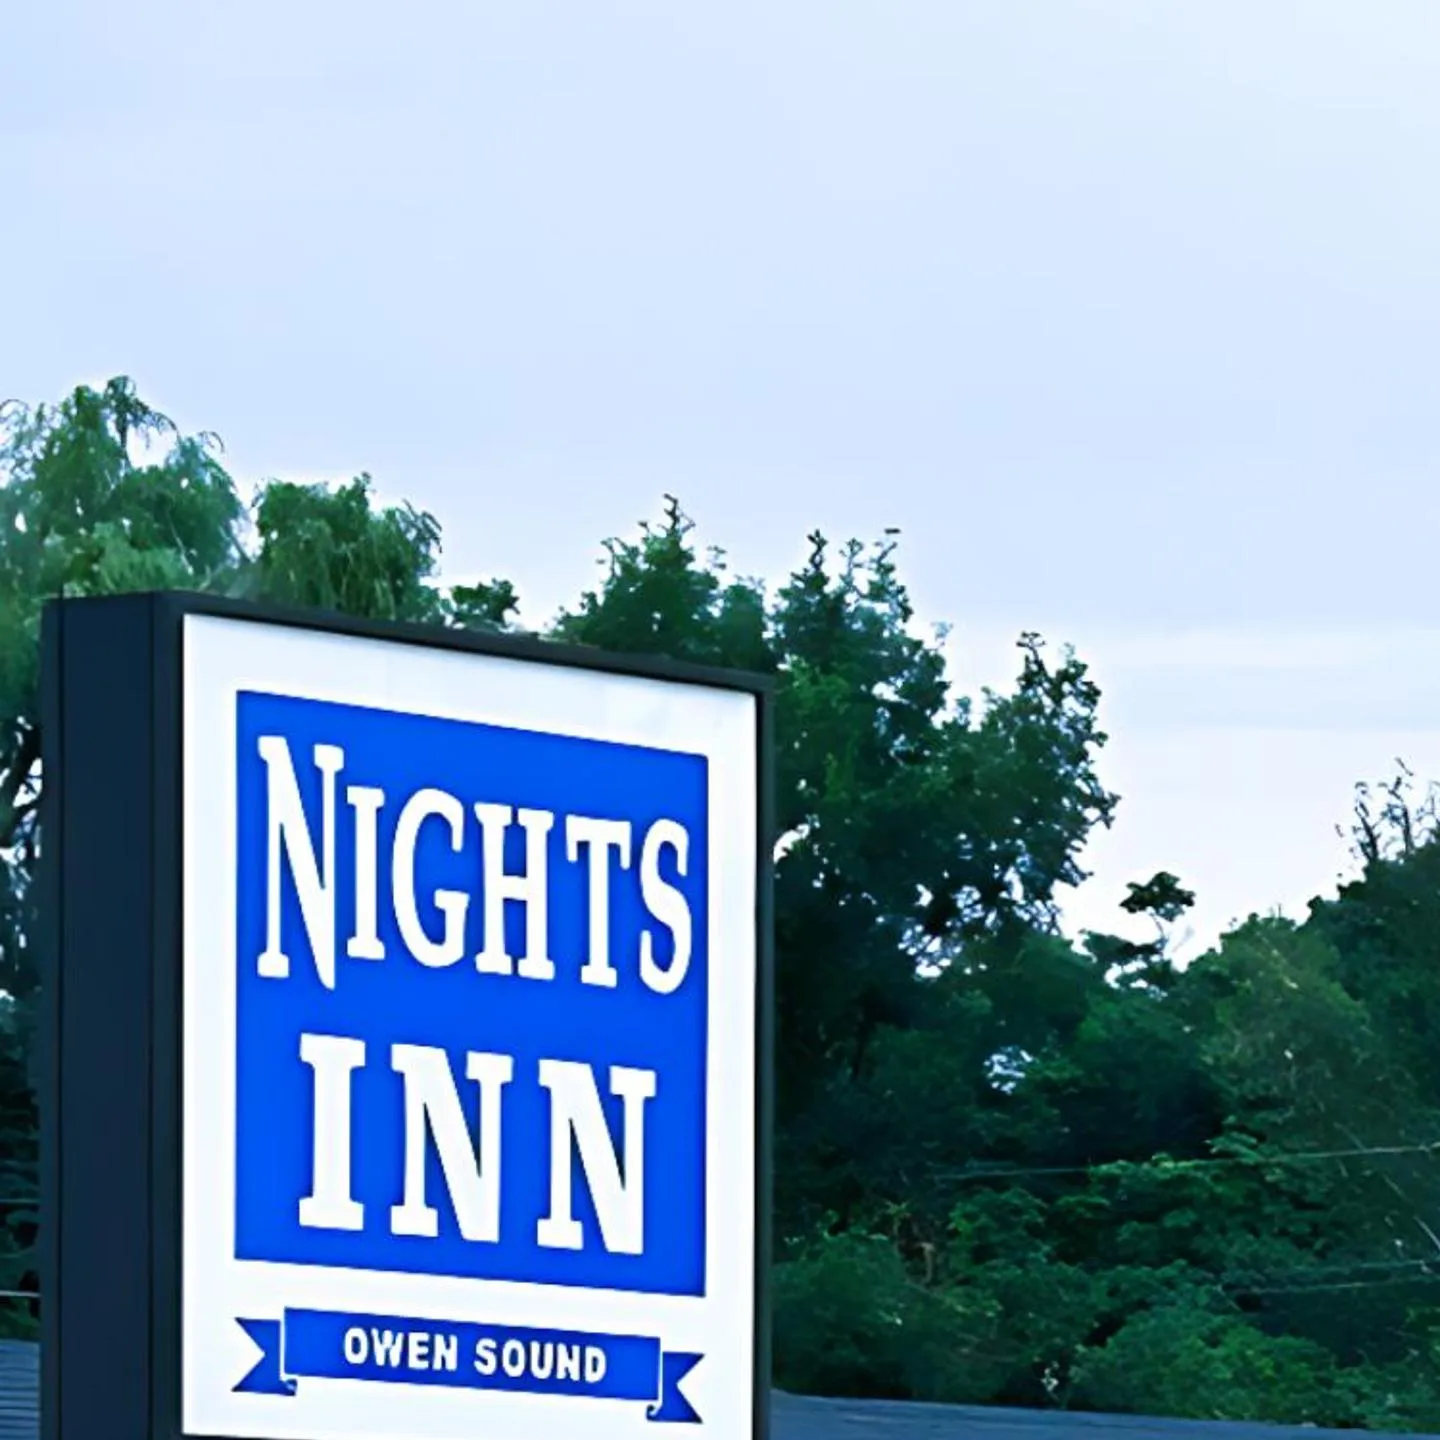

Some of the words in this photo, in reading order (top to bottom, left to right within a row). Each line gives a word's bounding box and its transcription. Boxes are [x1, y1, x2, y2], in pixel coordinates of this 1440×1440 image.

[257, 735, 693, 993] NIGHTS
[299, 1033, 656, 1256] INN
[344, 1325, 458, 1372] OWEN
[475, 1338, 608, 1384] SOUND
